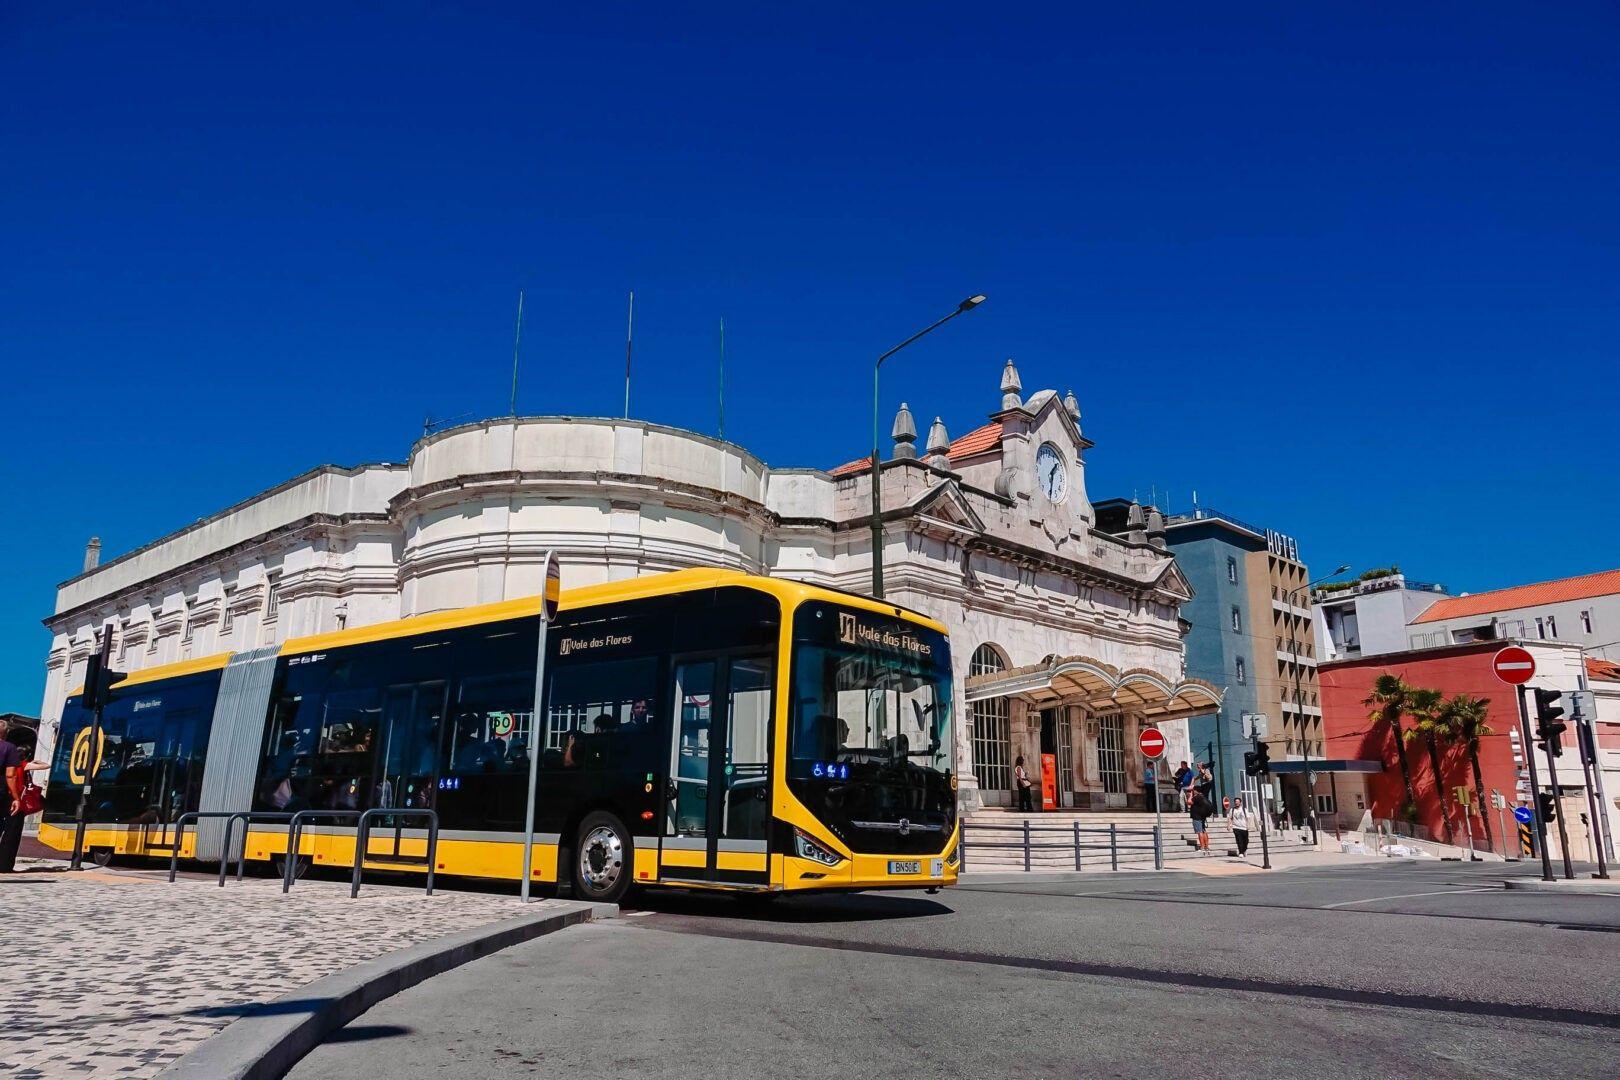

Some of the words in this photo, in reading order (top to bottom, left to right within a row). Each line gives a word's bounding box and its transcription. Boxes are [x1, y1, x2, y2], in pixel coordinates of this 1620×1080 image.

[1266, 528, 1302, 564] HOTEL
[571, 639, 588, 650] Vale
[590, 637, 604, 648] das
[605, 635, 633, 646] Flores
[858, 624, 881, 642] Vale
[883, 631, 900, 647] das
[902, 635, 931, 655] Flores
